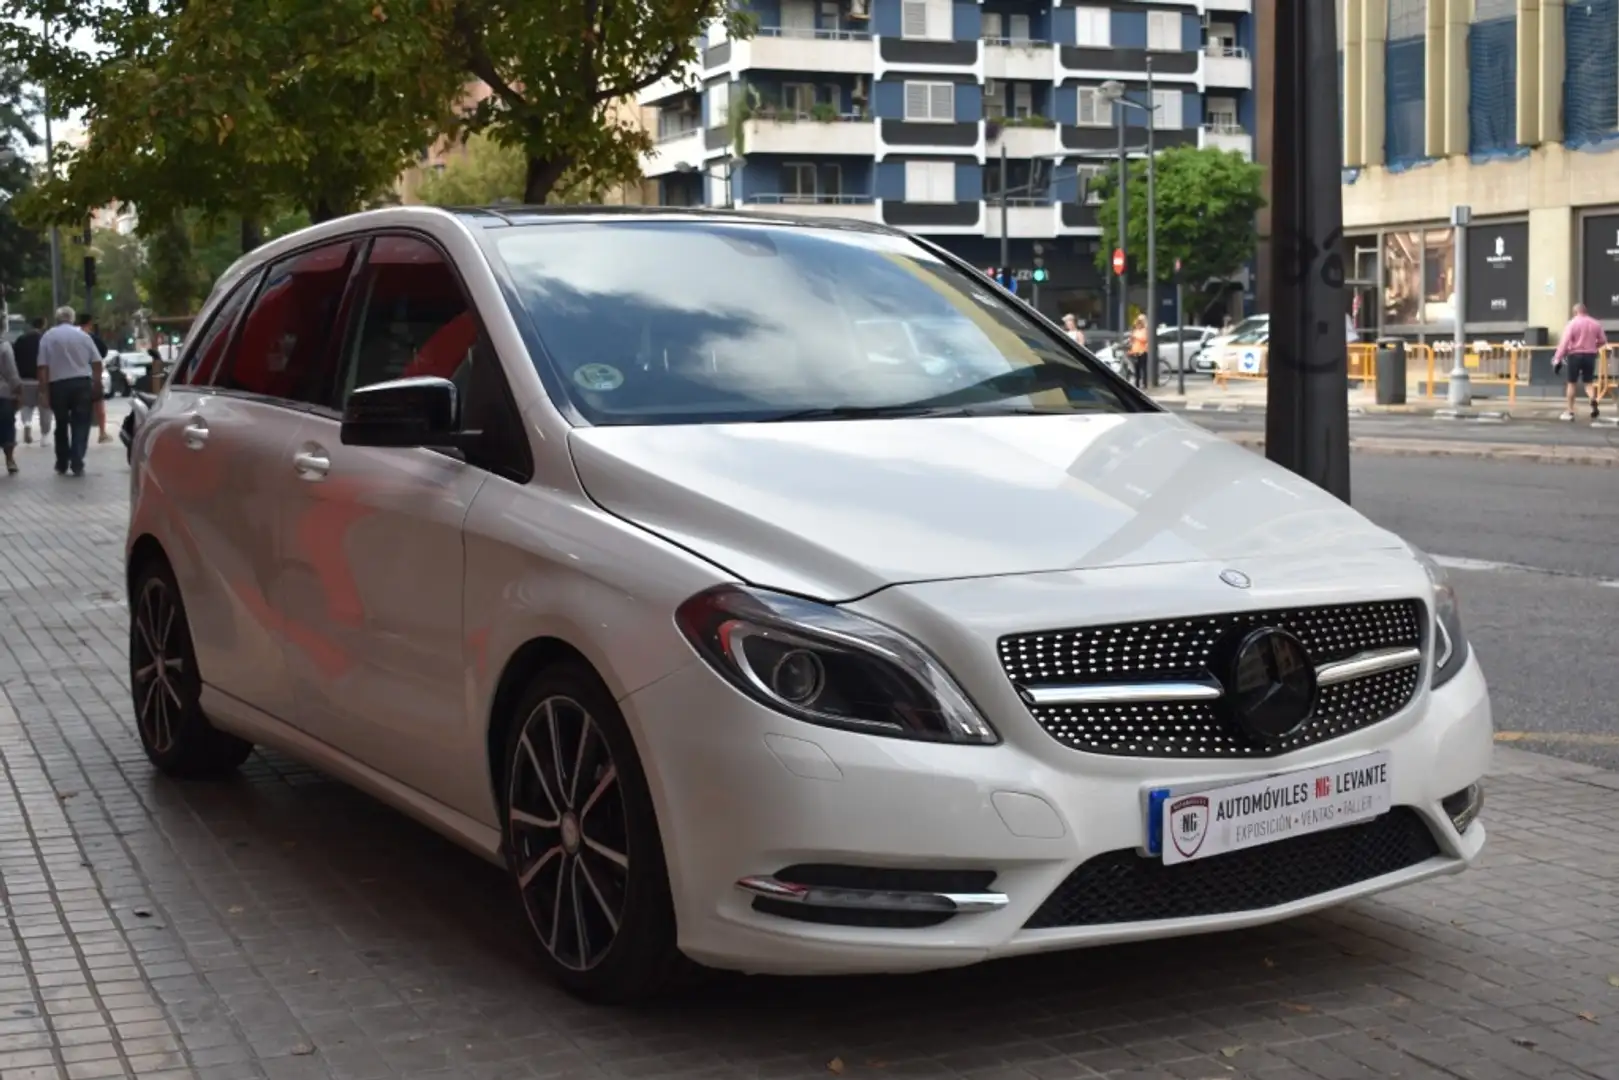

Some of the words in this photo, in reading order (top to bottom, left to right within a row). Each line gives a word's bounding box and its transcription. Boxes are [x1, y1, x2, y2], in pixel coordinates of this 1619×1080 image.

[1216, 783, 1308, 822] AUTOMÓVILES
[1314, 776, 1332, 798] NG
[1336, 763, 1387, 794] LEVANTE
[1182, 812, 1197, 833] NG
[1236, 814, 1292, 843] EXPOSICIÓN
[1301, 805, 1335, 827] VENTAS
[1342, 795, 1373, 815] TALLER
